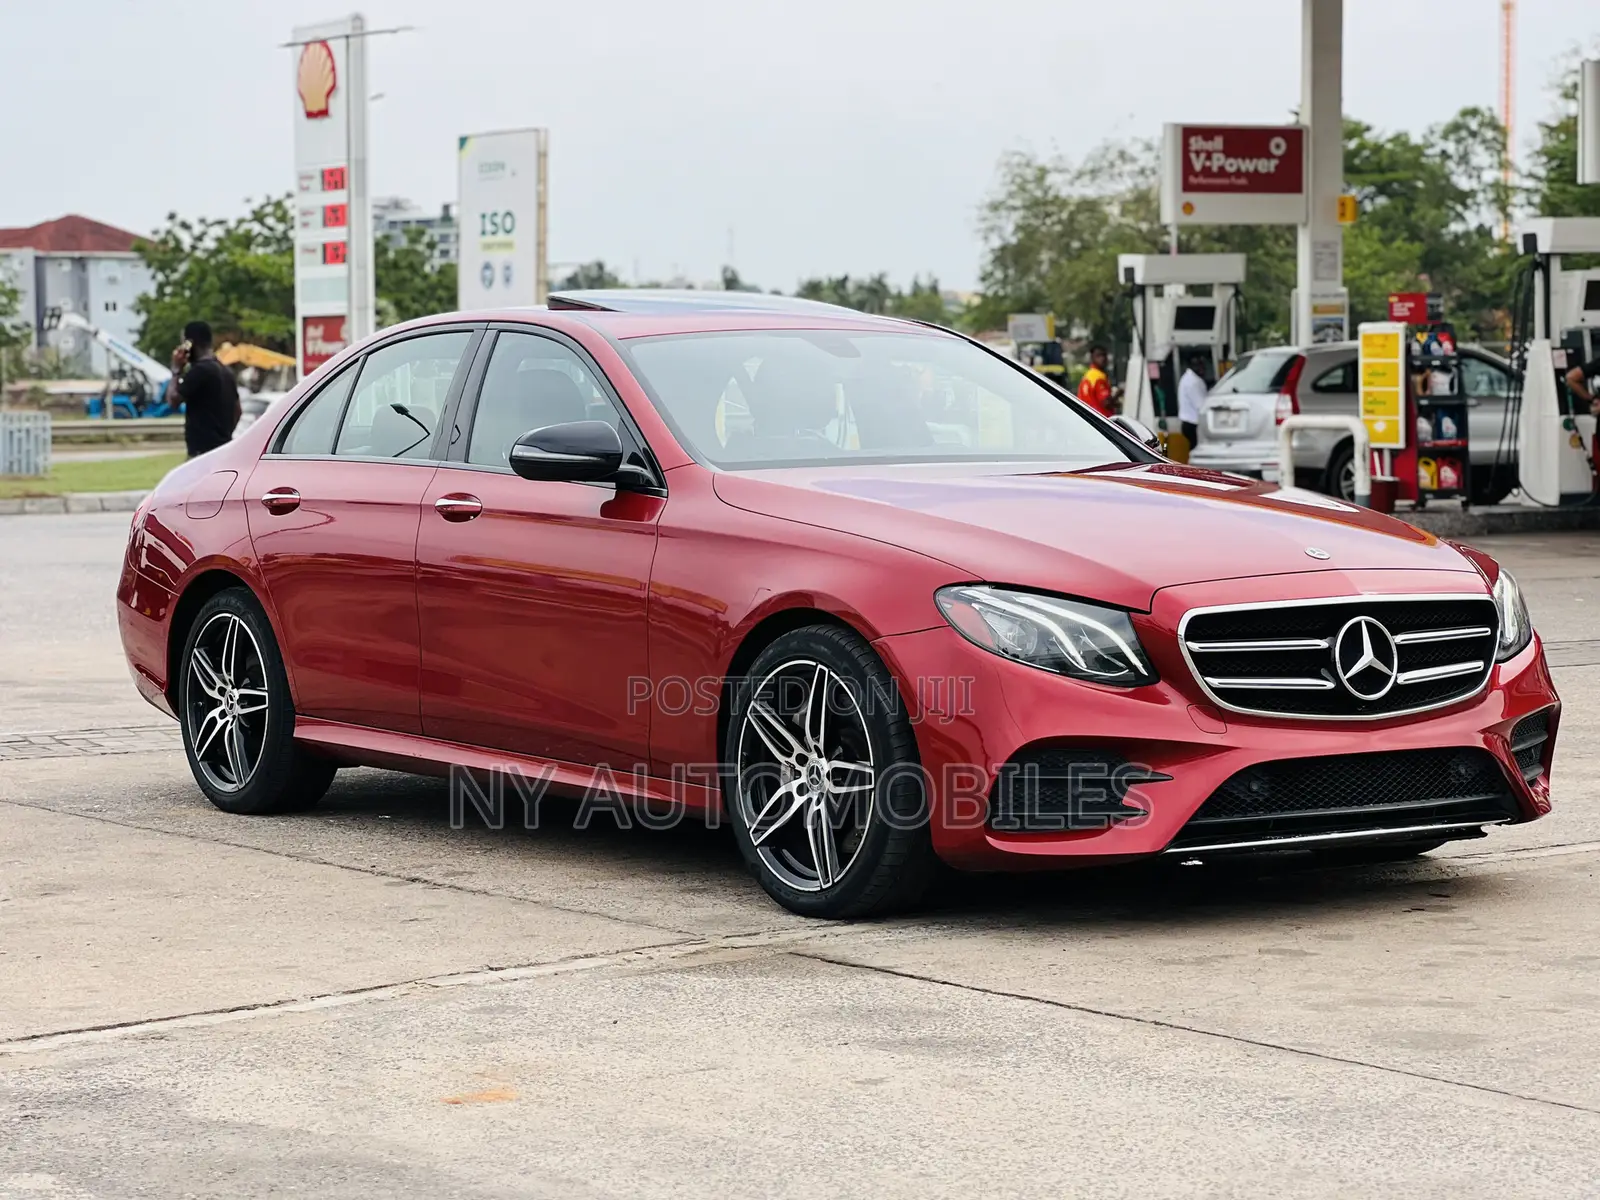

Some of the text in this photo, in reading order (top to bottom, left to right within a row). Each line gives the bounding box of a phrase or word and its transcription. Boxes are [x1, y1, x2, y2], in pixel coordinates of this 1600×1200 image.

[1188, 136, 1223, 151] Shell
[1188, 153, 1279, 173] V-Power
[480, 209, 514, 236] ISO
